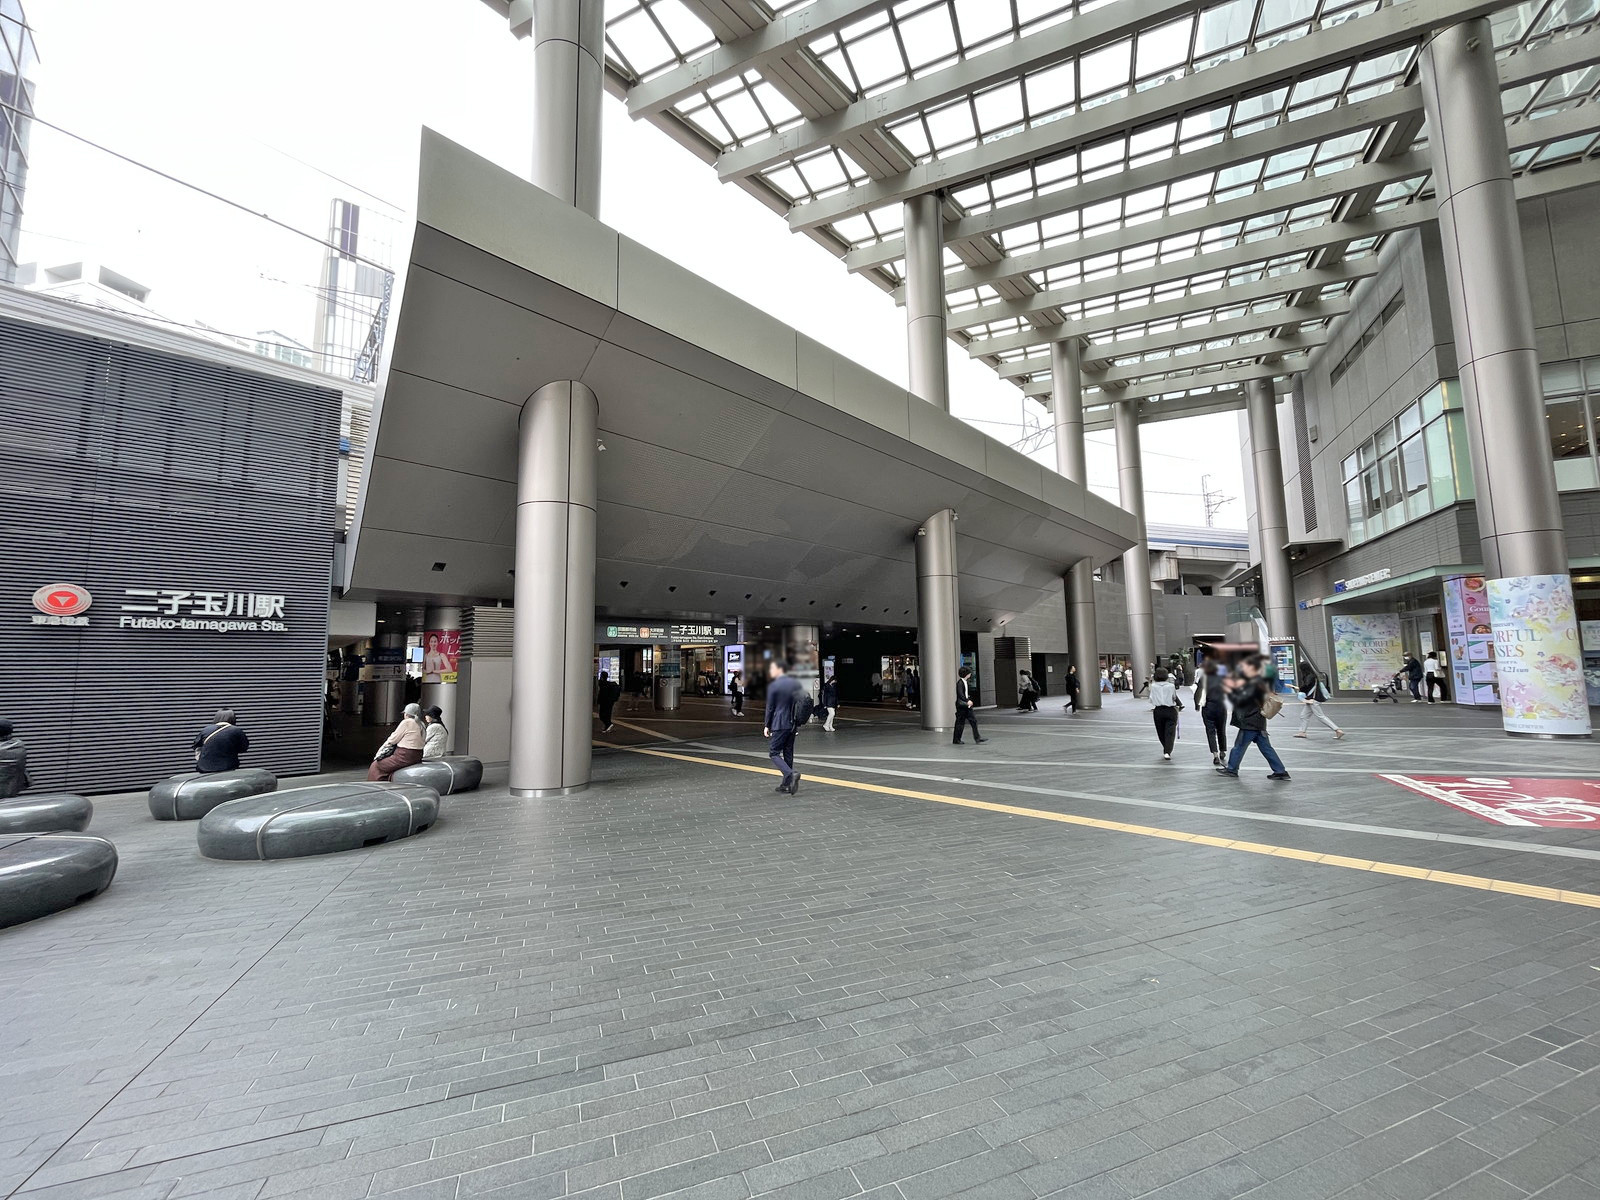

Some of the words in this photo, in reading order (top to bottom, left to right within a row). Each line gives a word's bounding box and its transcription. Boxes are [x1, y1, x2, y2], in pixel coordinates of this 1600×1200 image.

[121, 589, 286, 617] 二子玉川駅
[119, 615, 257, 632] Futako-tamagawa
[261, 620, 289, 632] Sta.
[671, 625, 712, 636] 二子玉川駅
